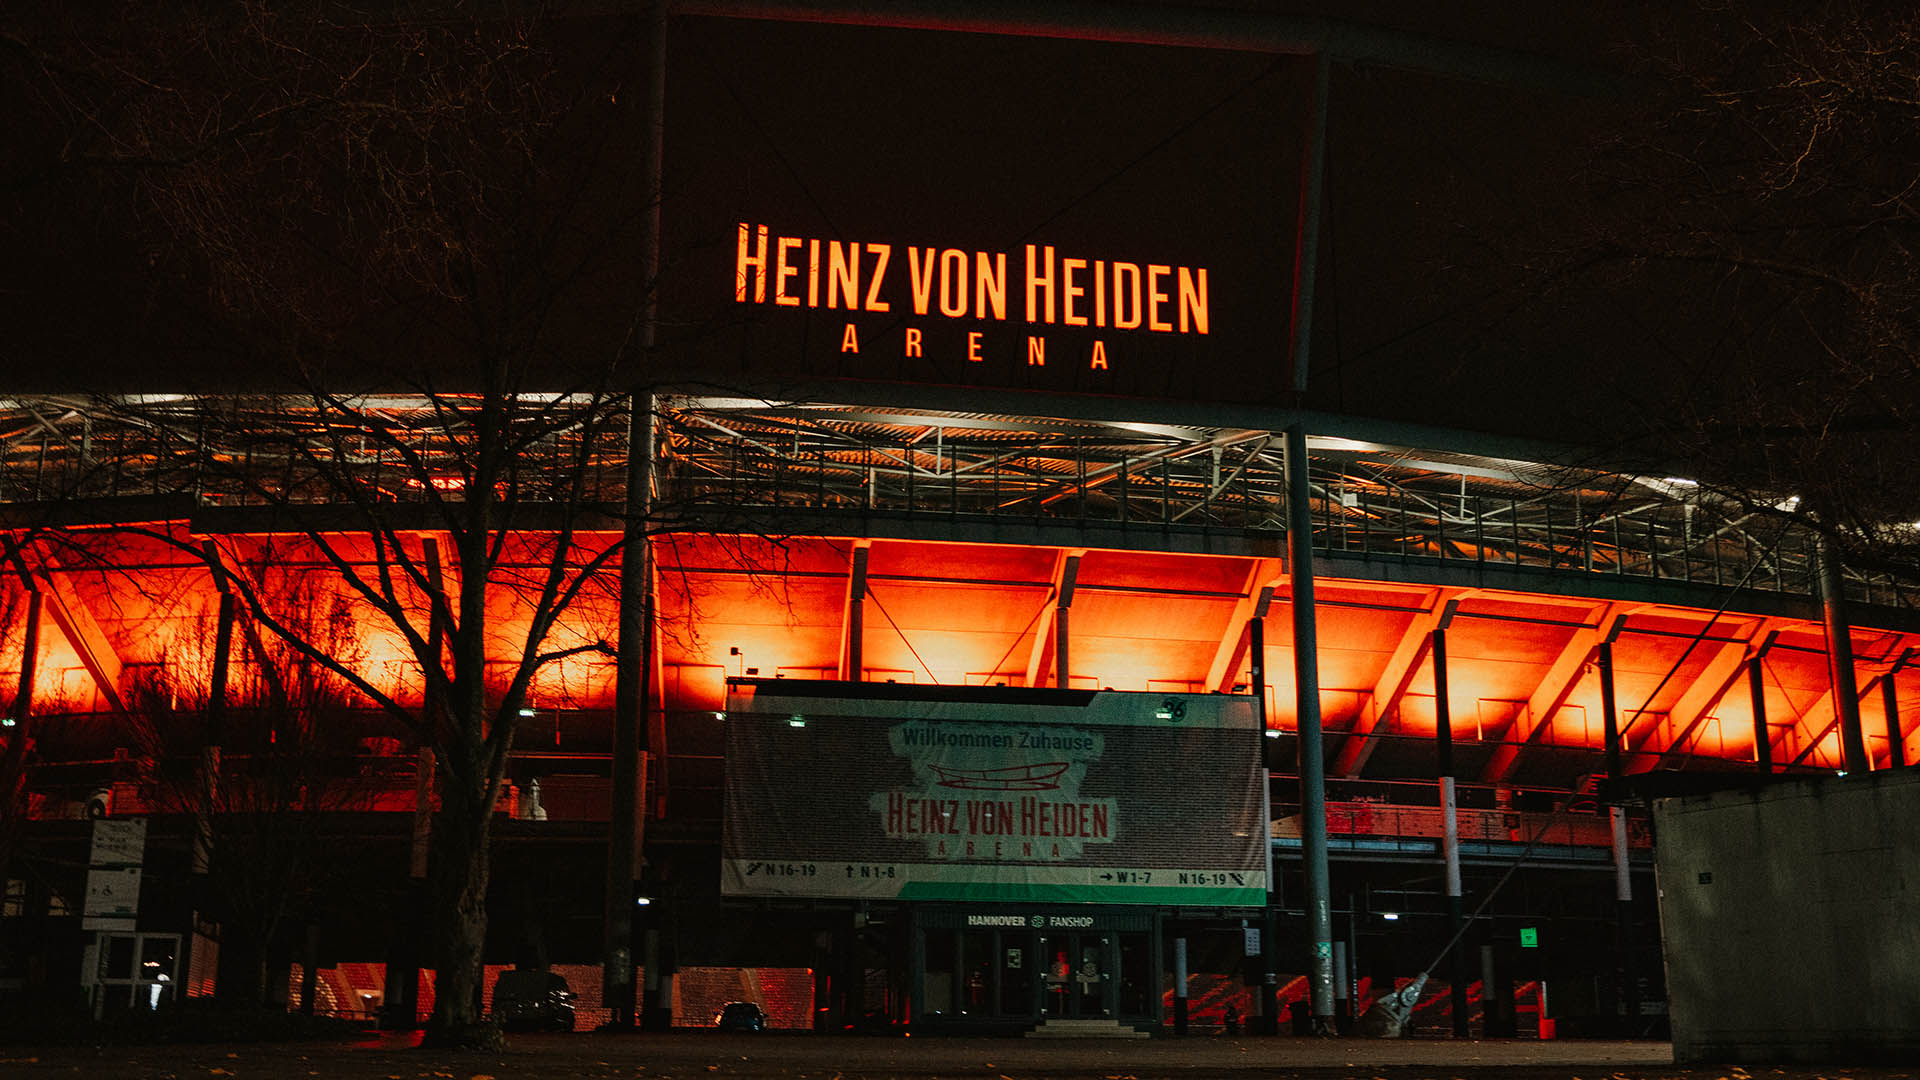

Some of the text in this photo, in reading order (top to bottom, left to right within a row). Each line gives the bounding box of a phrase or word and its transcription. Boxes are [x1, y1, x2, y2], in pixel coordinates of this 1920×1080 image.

[735, 222, 1209, 335] HEINZ VON HEIDEN
[841, 323, 1109, 370] ARENA
[902, 726, 1093, 752] Willkommen Zuhause
[887, 792, 1108, 838] HEINZ VON HEIDEN
[938, 840, 1060, 858] ARENA
[766, 863, 816, 876] N 16-19
[861, 866, 895, 878] N 1-8
[1117, 871, 1151, 884] W 1-7
[1179, 872, 1226, 885] N 16-19
[967, 914, 1026, 927] HANNOVER
[1049, 916, 1094, 928] FANSHOP
